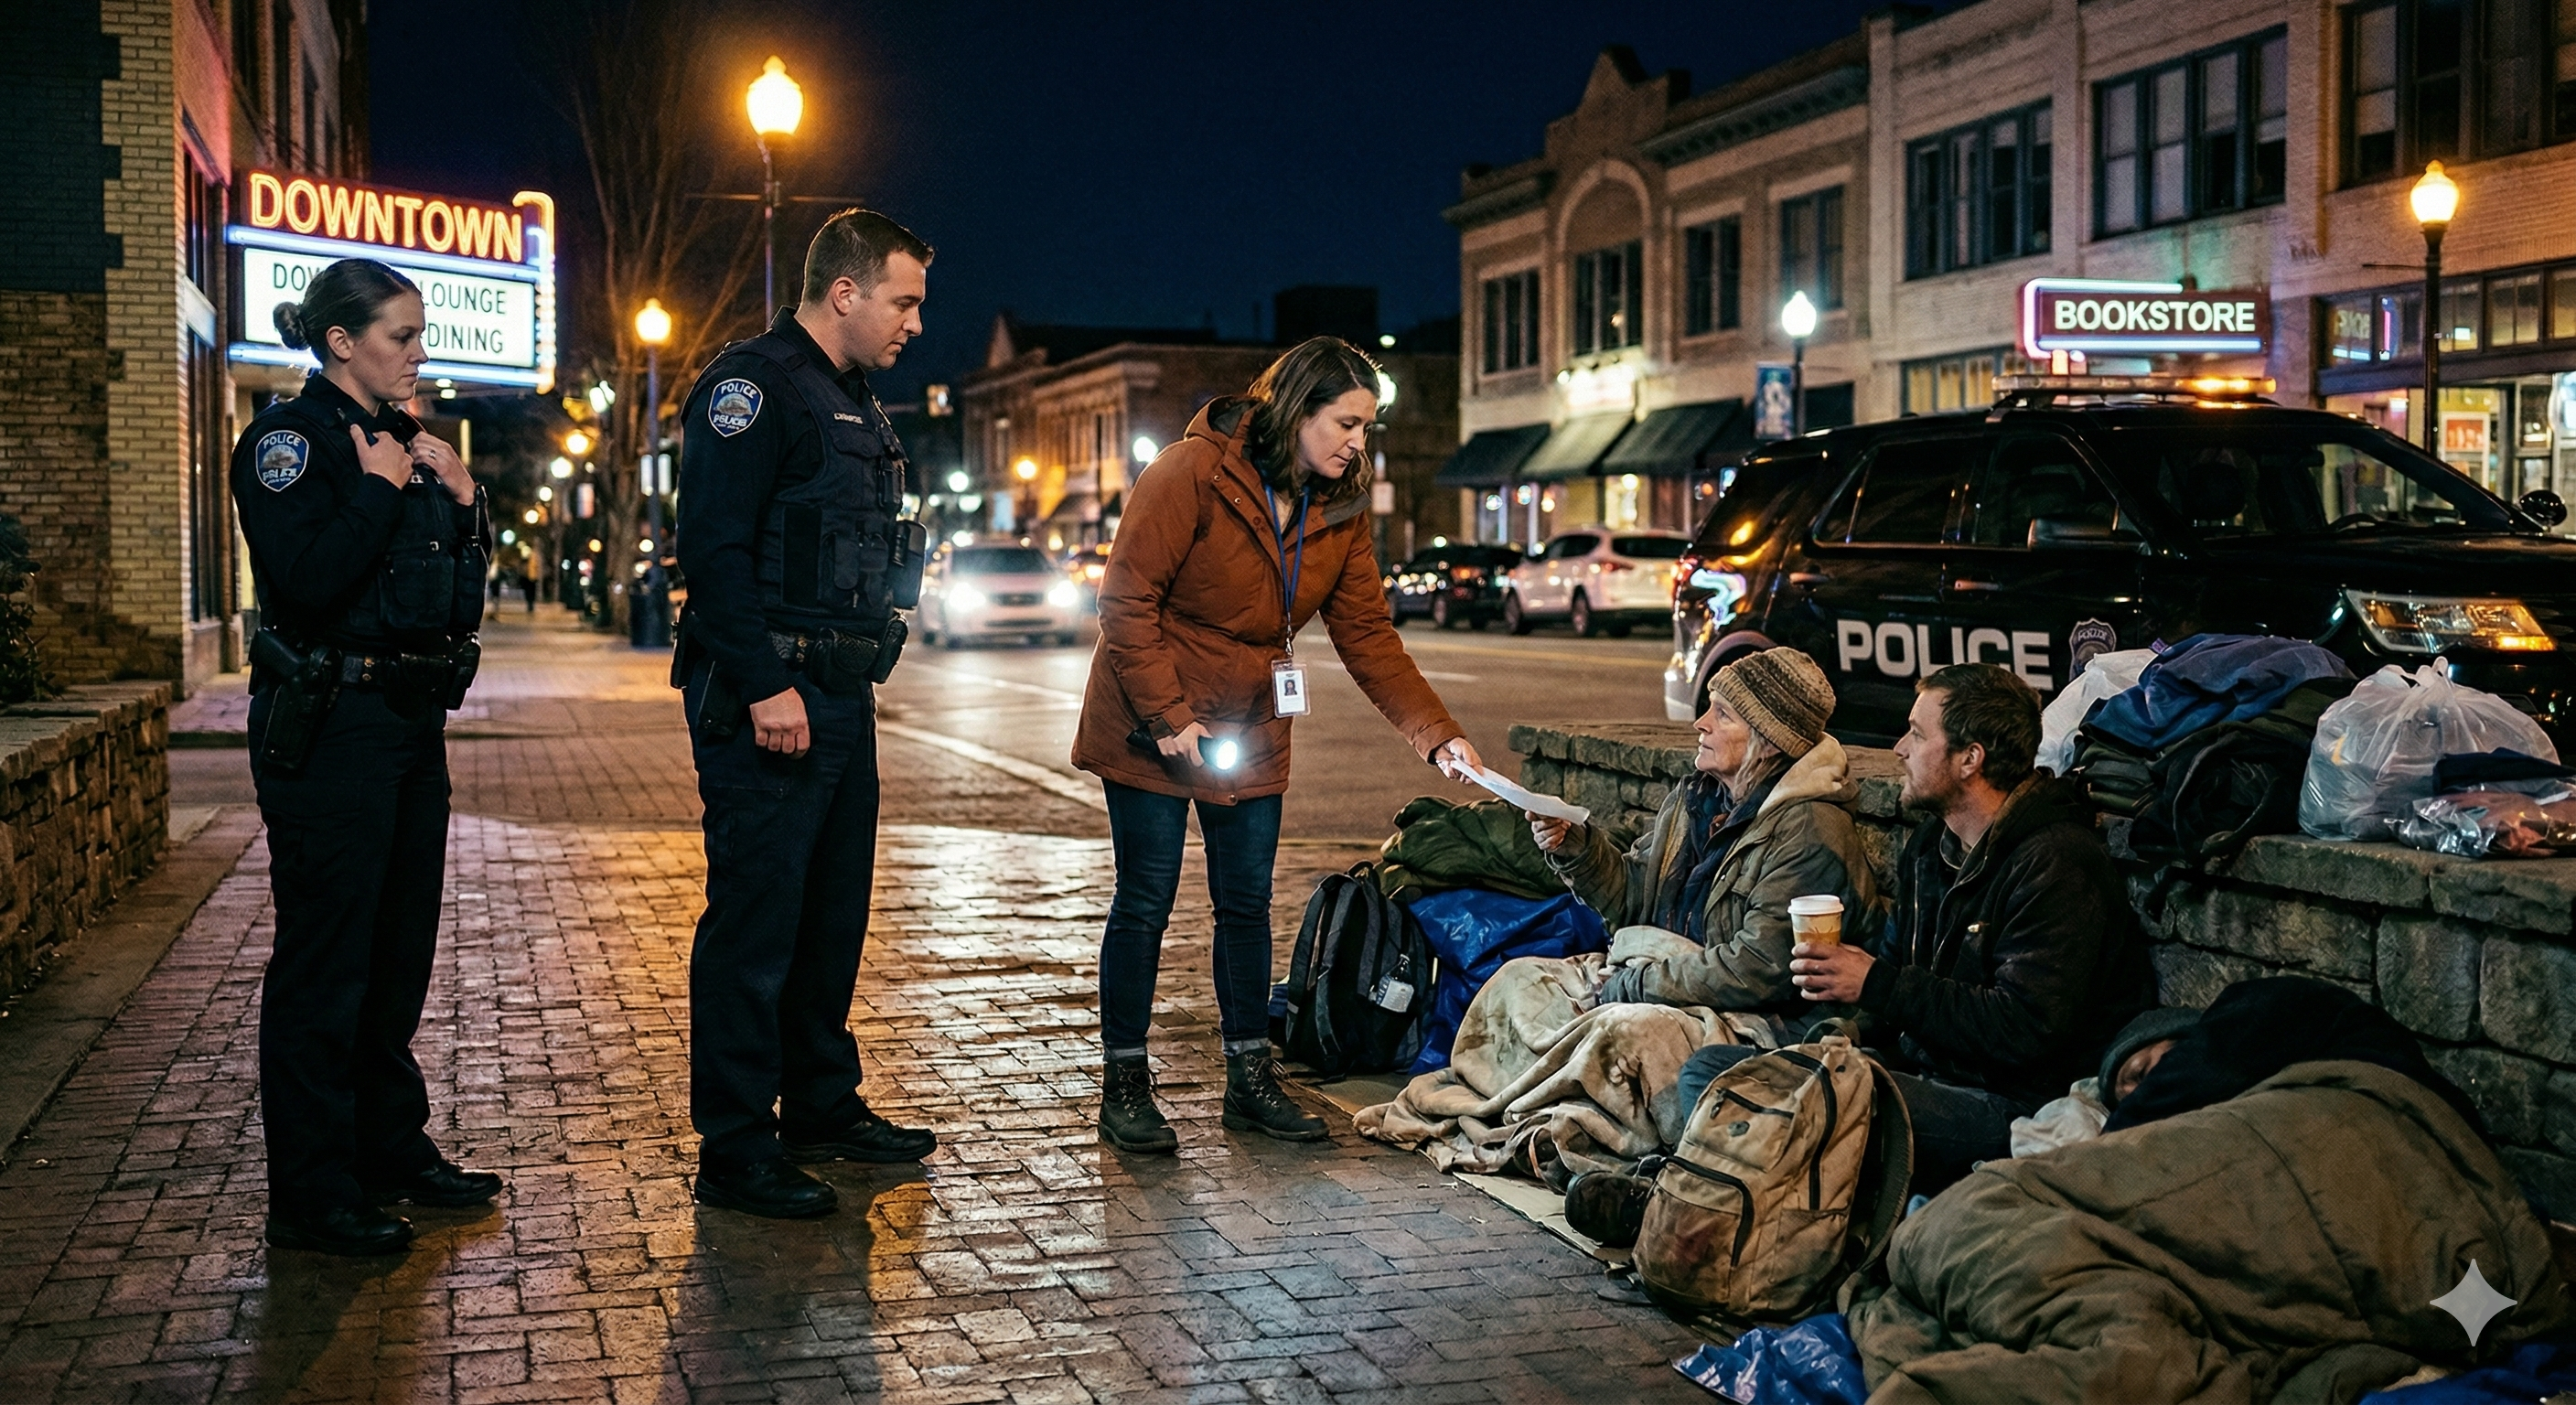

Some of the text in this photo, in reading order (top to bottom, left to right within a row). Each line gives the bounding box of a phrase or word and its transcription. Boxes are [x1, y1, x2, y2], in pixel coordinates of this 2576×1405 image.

[250, 172, 522, 263] DOWNTOWN
[2055, 299, 2256, 332] BOOKSTORE
[427, 322, 503, 353] DINING
[263, 434, 302, 449] POLICE
[1837, 618, 2055, 692] POLICE
